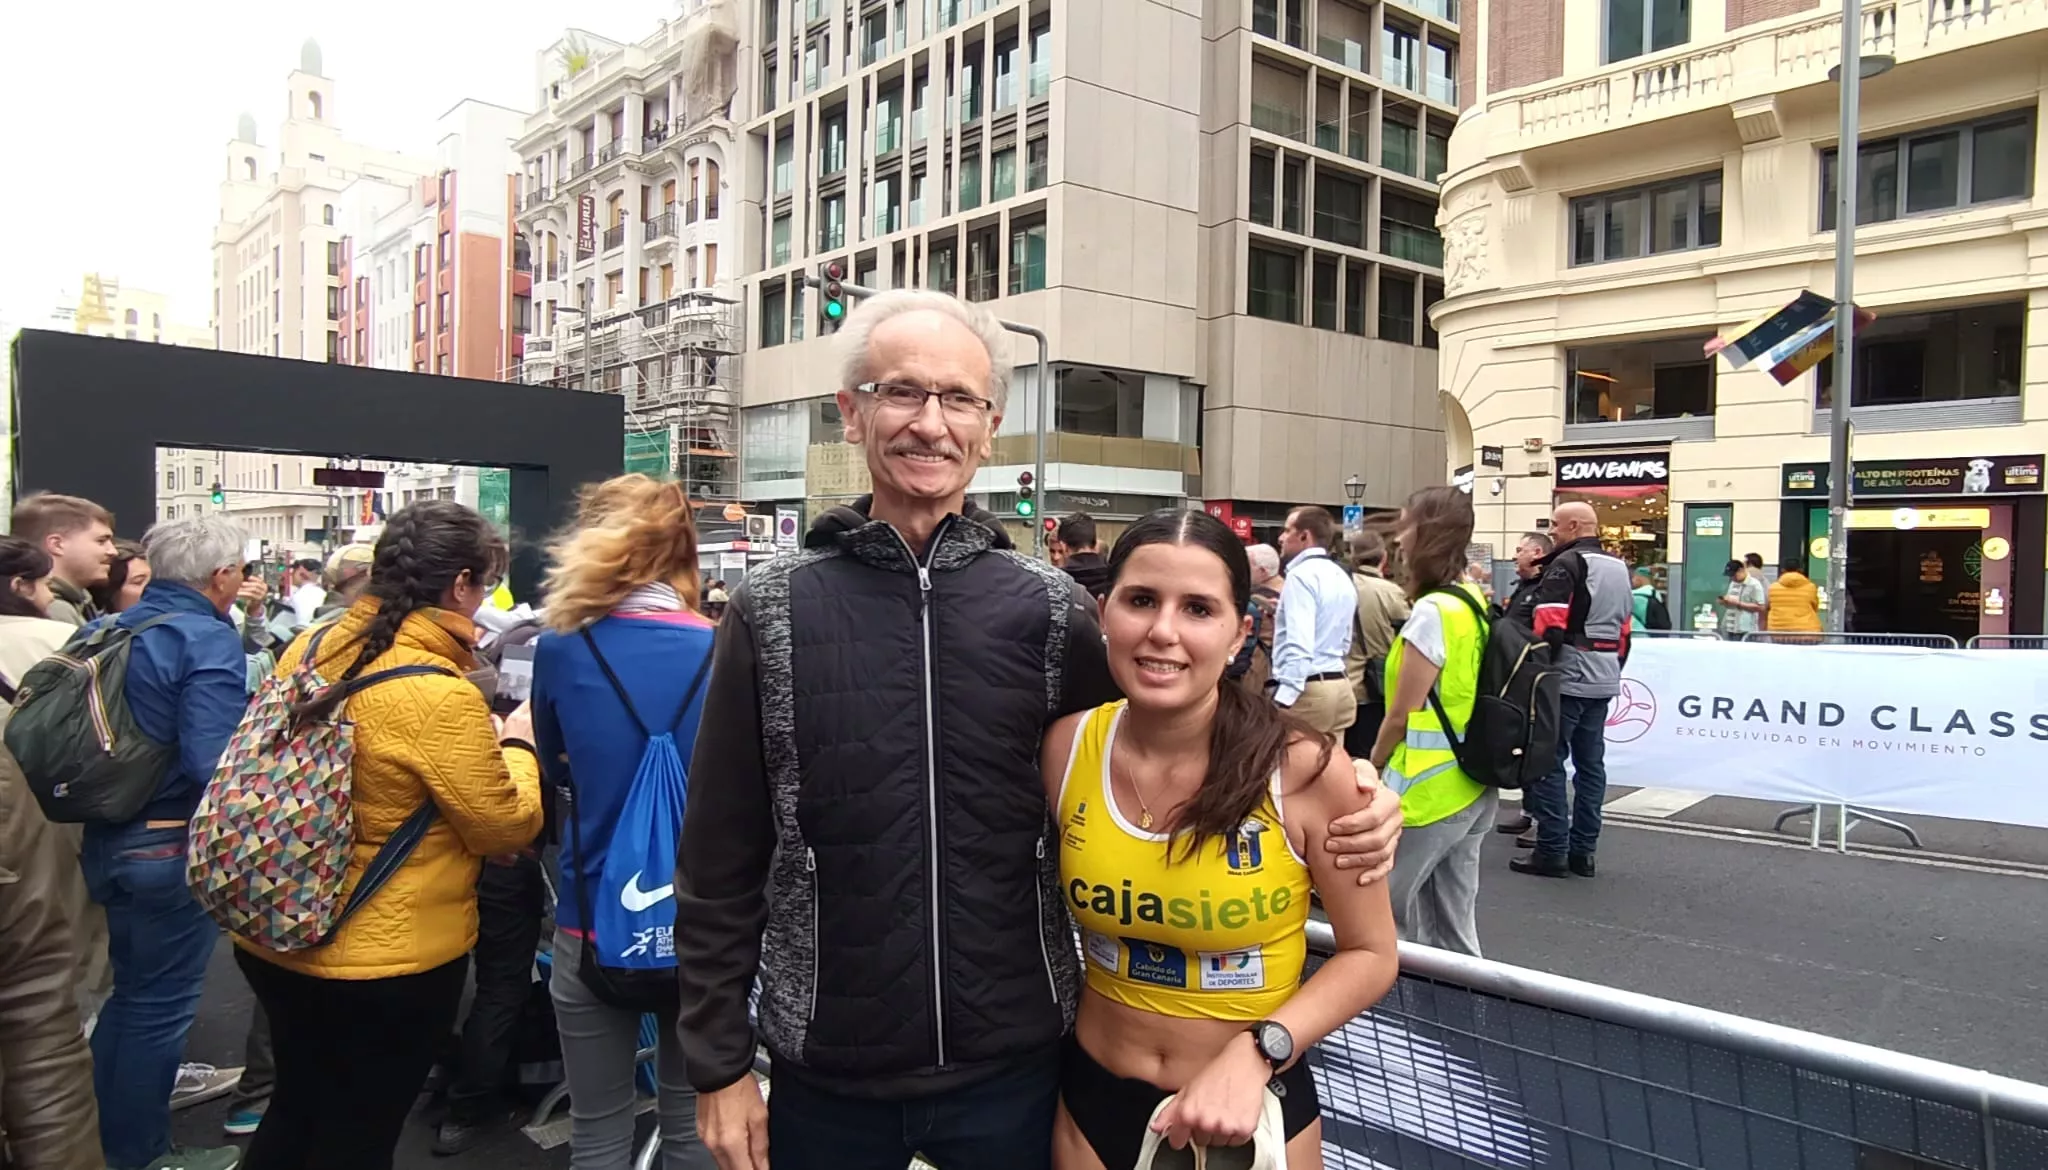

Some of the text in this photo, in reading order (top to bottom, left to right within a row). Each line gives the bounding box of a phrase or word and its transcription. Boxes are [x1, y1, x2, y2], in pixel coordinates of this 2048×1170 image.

[582, 198, 591, 239] LAURIA
[1561, 460, 1667, 480] SOUVENIRS
[1882, 470, 1896, 478] EN
[1898, 467, 1960, 477] PROTEÍNAS
[1863, 478, 1950, 487] DE ALTA CALIDAD
[1678, 695, 2048, 741] GRAND CLASS
[1676, 726, 1985, 757] EXCLUSIVIDAD EN MOVIMIENTO
[1069, 878, 1291, 931] cajasiete
[656, 926, 674, 938] EU
[1131, 968, 1182, 983] Gran Canaria
[1135, 961, 1165, 973] Cabildo
